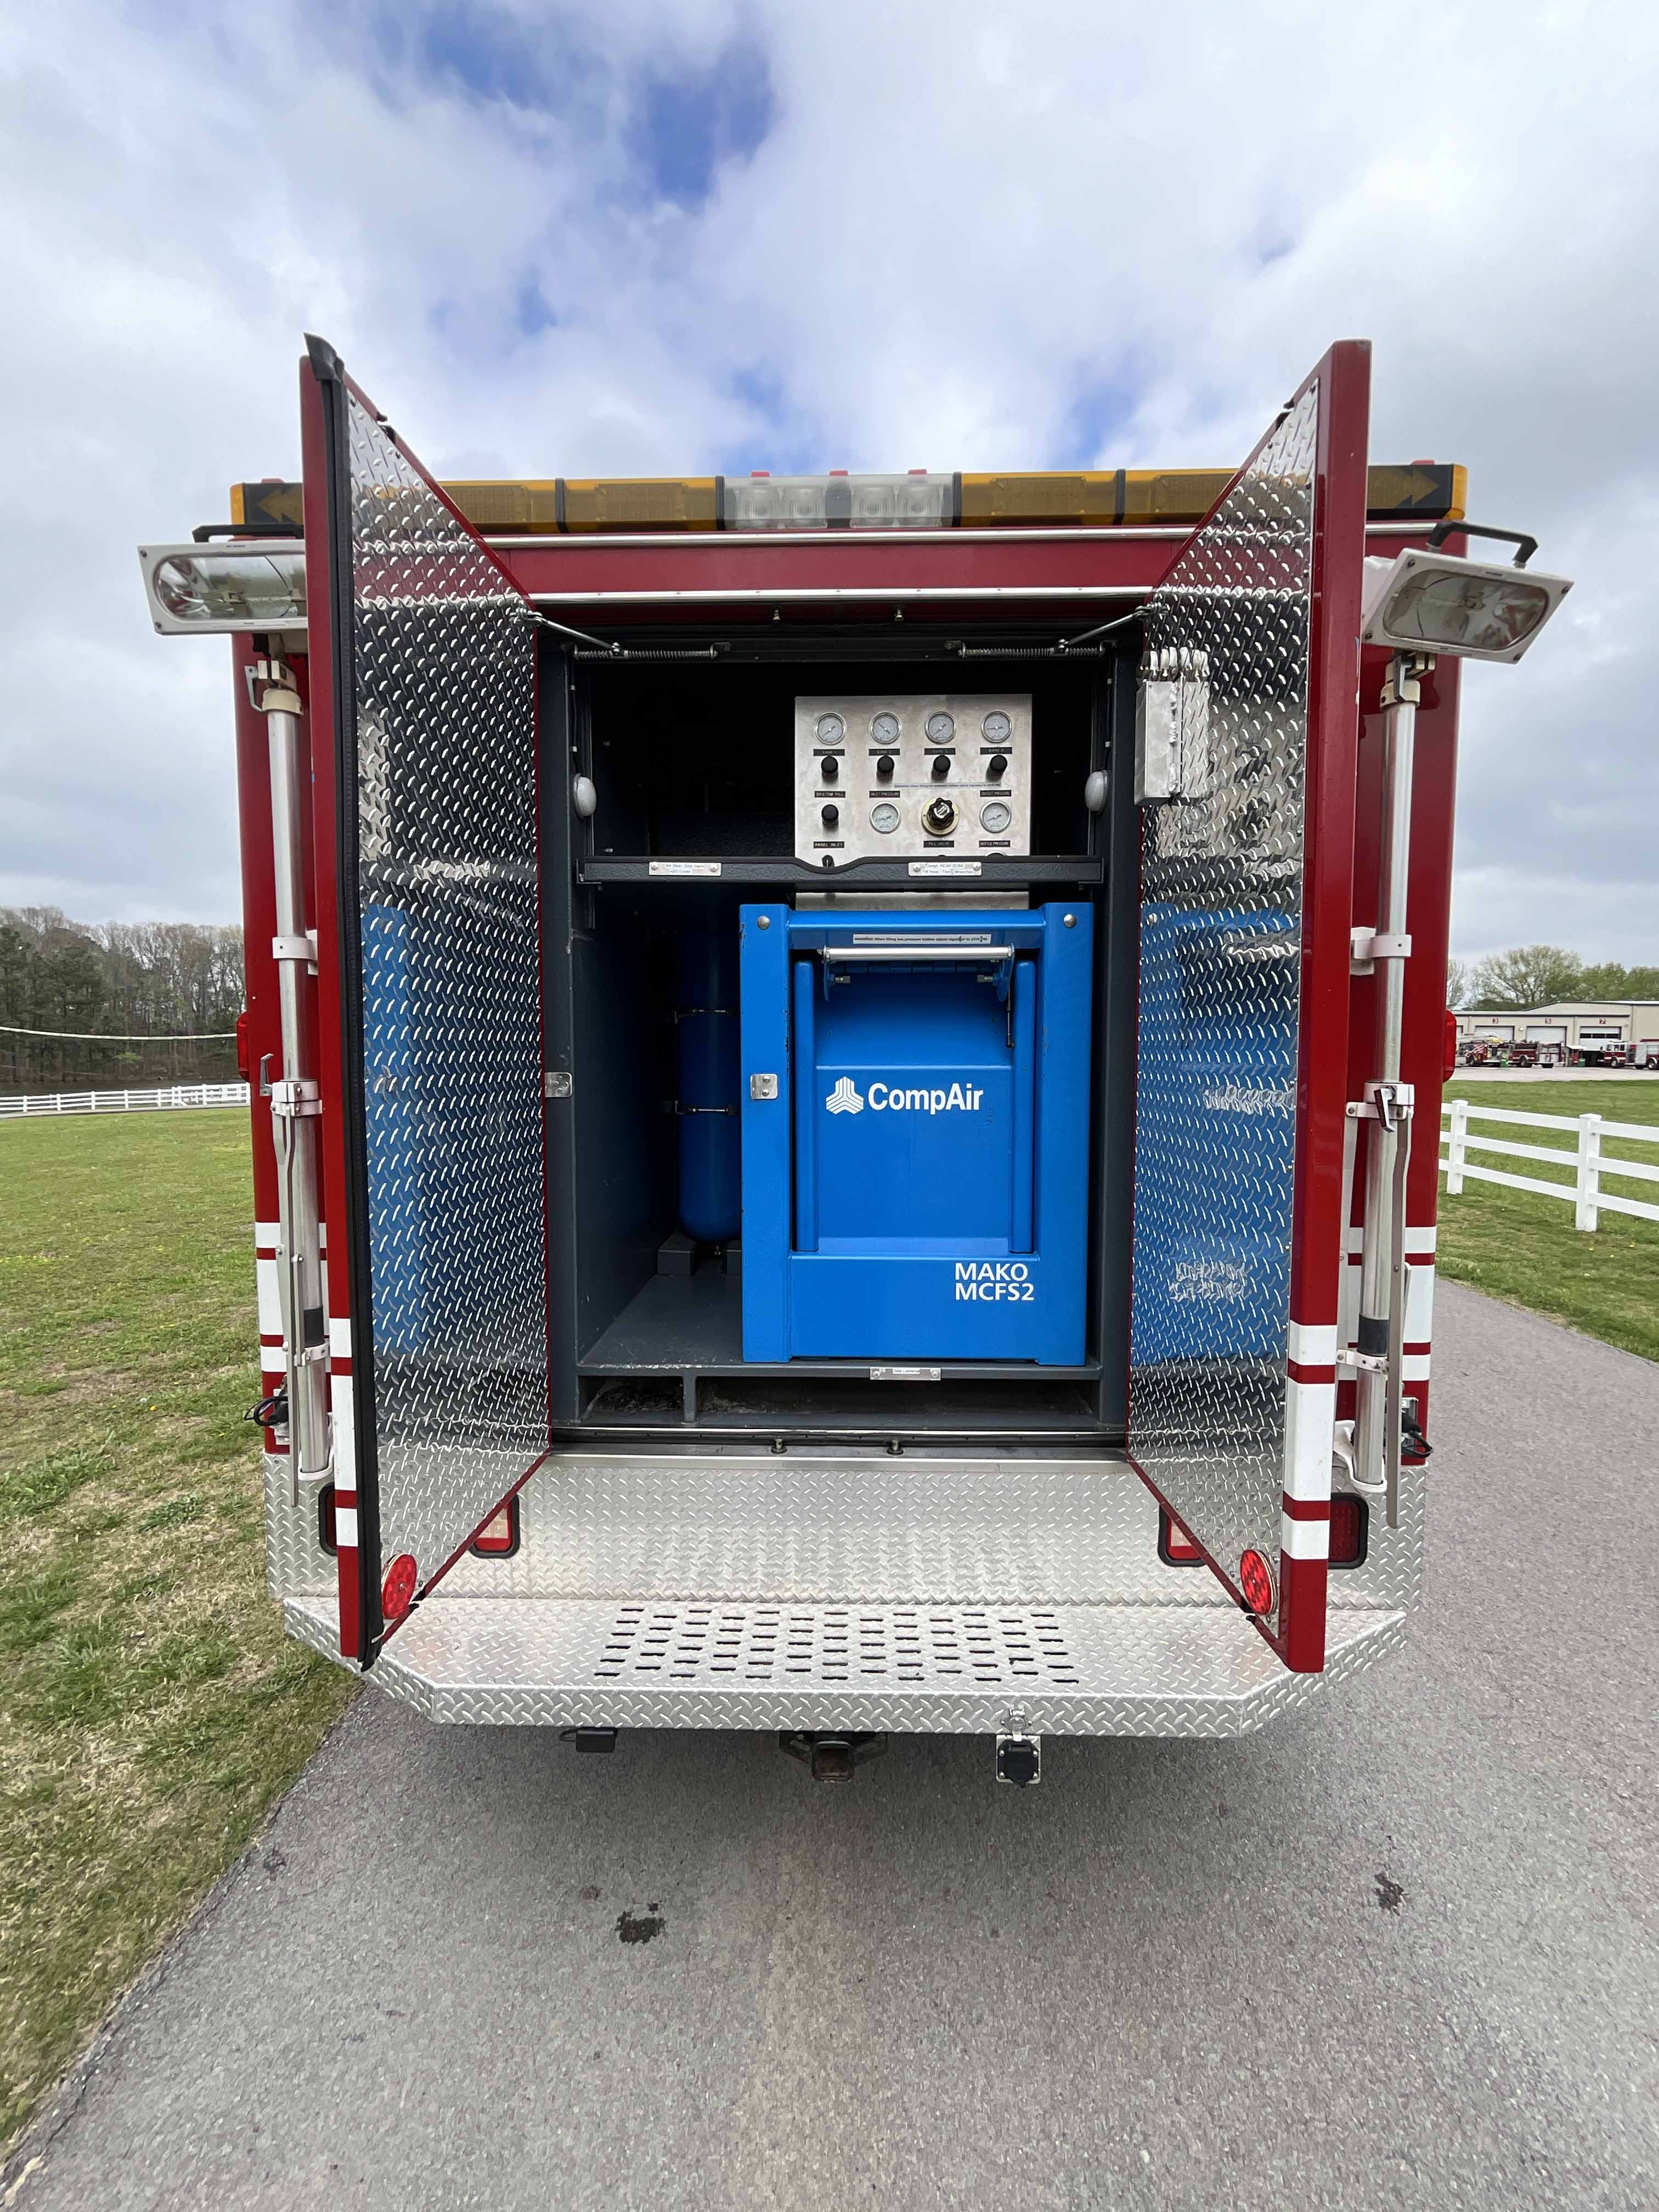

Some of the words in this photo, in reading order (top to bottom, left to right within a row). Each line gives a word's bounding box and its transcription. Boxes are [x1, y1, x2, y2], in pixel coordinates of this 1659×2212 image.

[868, 1083, 984, 1115] CompAir
[955, 1262, 1029, 1282] MAKO
[956, 1282, 1035, 1301] MCFS2
